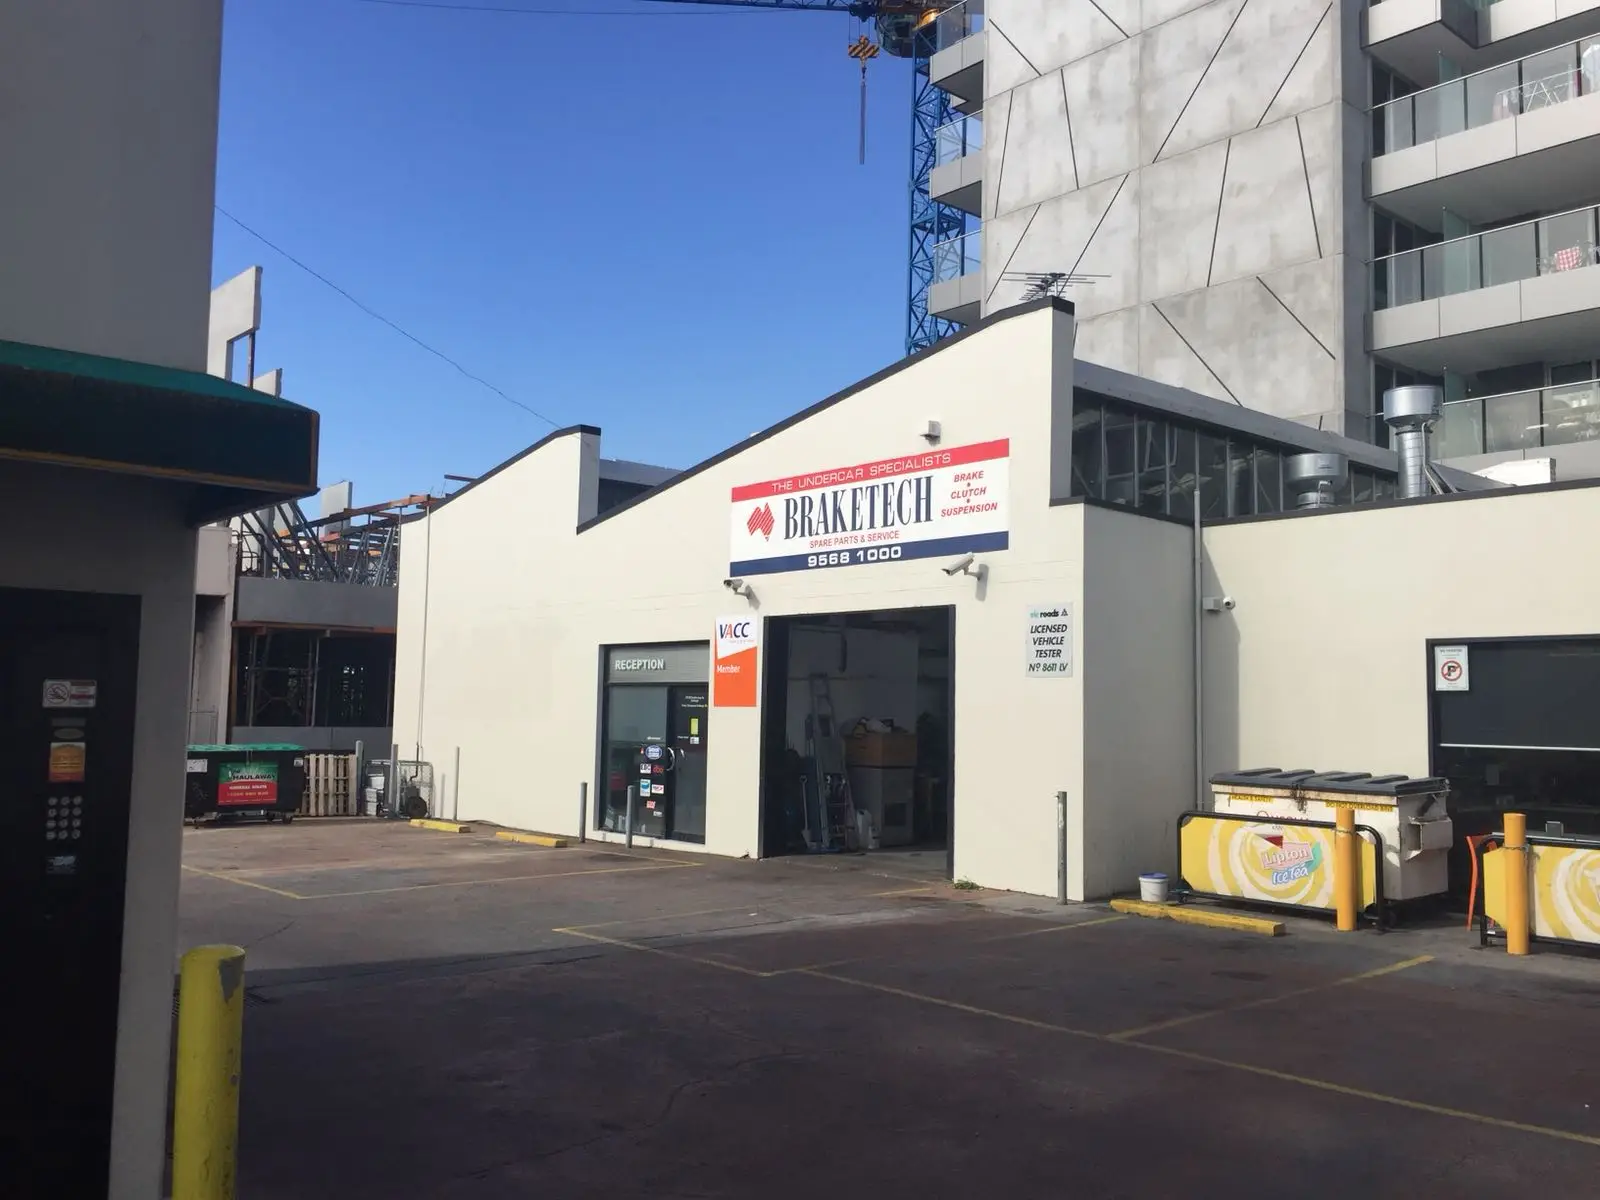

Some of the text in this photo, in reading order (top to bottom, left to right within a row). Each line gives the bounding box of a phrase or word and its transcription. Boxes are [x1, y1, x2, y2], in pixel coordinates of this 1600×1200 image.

[771, 452, 951, 493] THE UNDERCAR SPECIALISTS
[953, 470, 984, 483] BRAKE
[950, 486, 987, 500] CLUTCH
[784, 475, 934, 540] BRAKETECH
[940, 501, 998, 518] SUSPENSION
[809, 530, 900, 549] SPARE PARTS & SERVICE
[807, 546, 902, 567] 9568 1000
[719, 622, 750, 639] VACC
[1030, 624, 1068, 634] LICENSED
[1032, 636, 1065, 646] VEHICLE
[1035, 649, 1062, 658] TESTER
[614, 658, 665, 671] RECEPTION
[716, 663, 741, 673] Member
[1264, 848, 1309, 867] Lipton
[1272, 861, 1309, 885] Ice Tea
